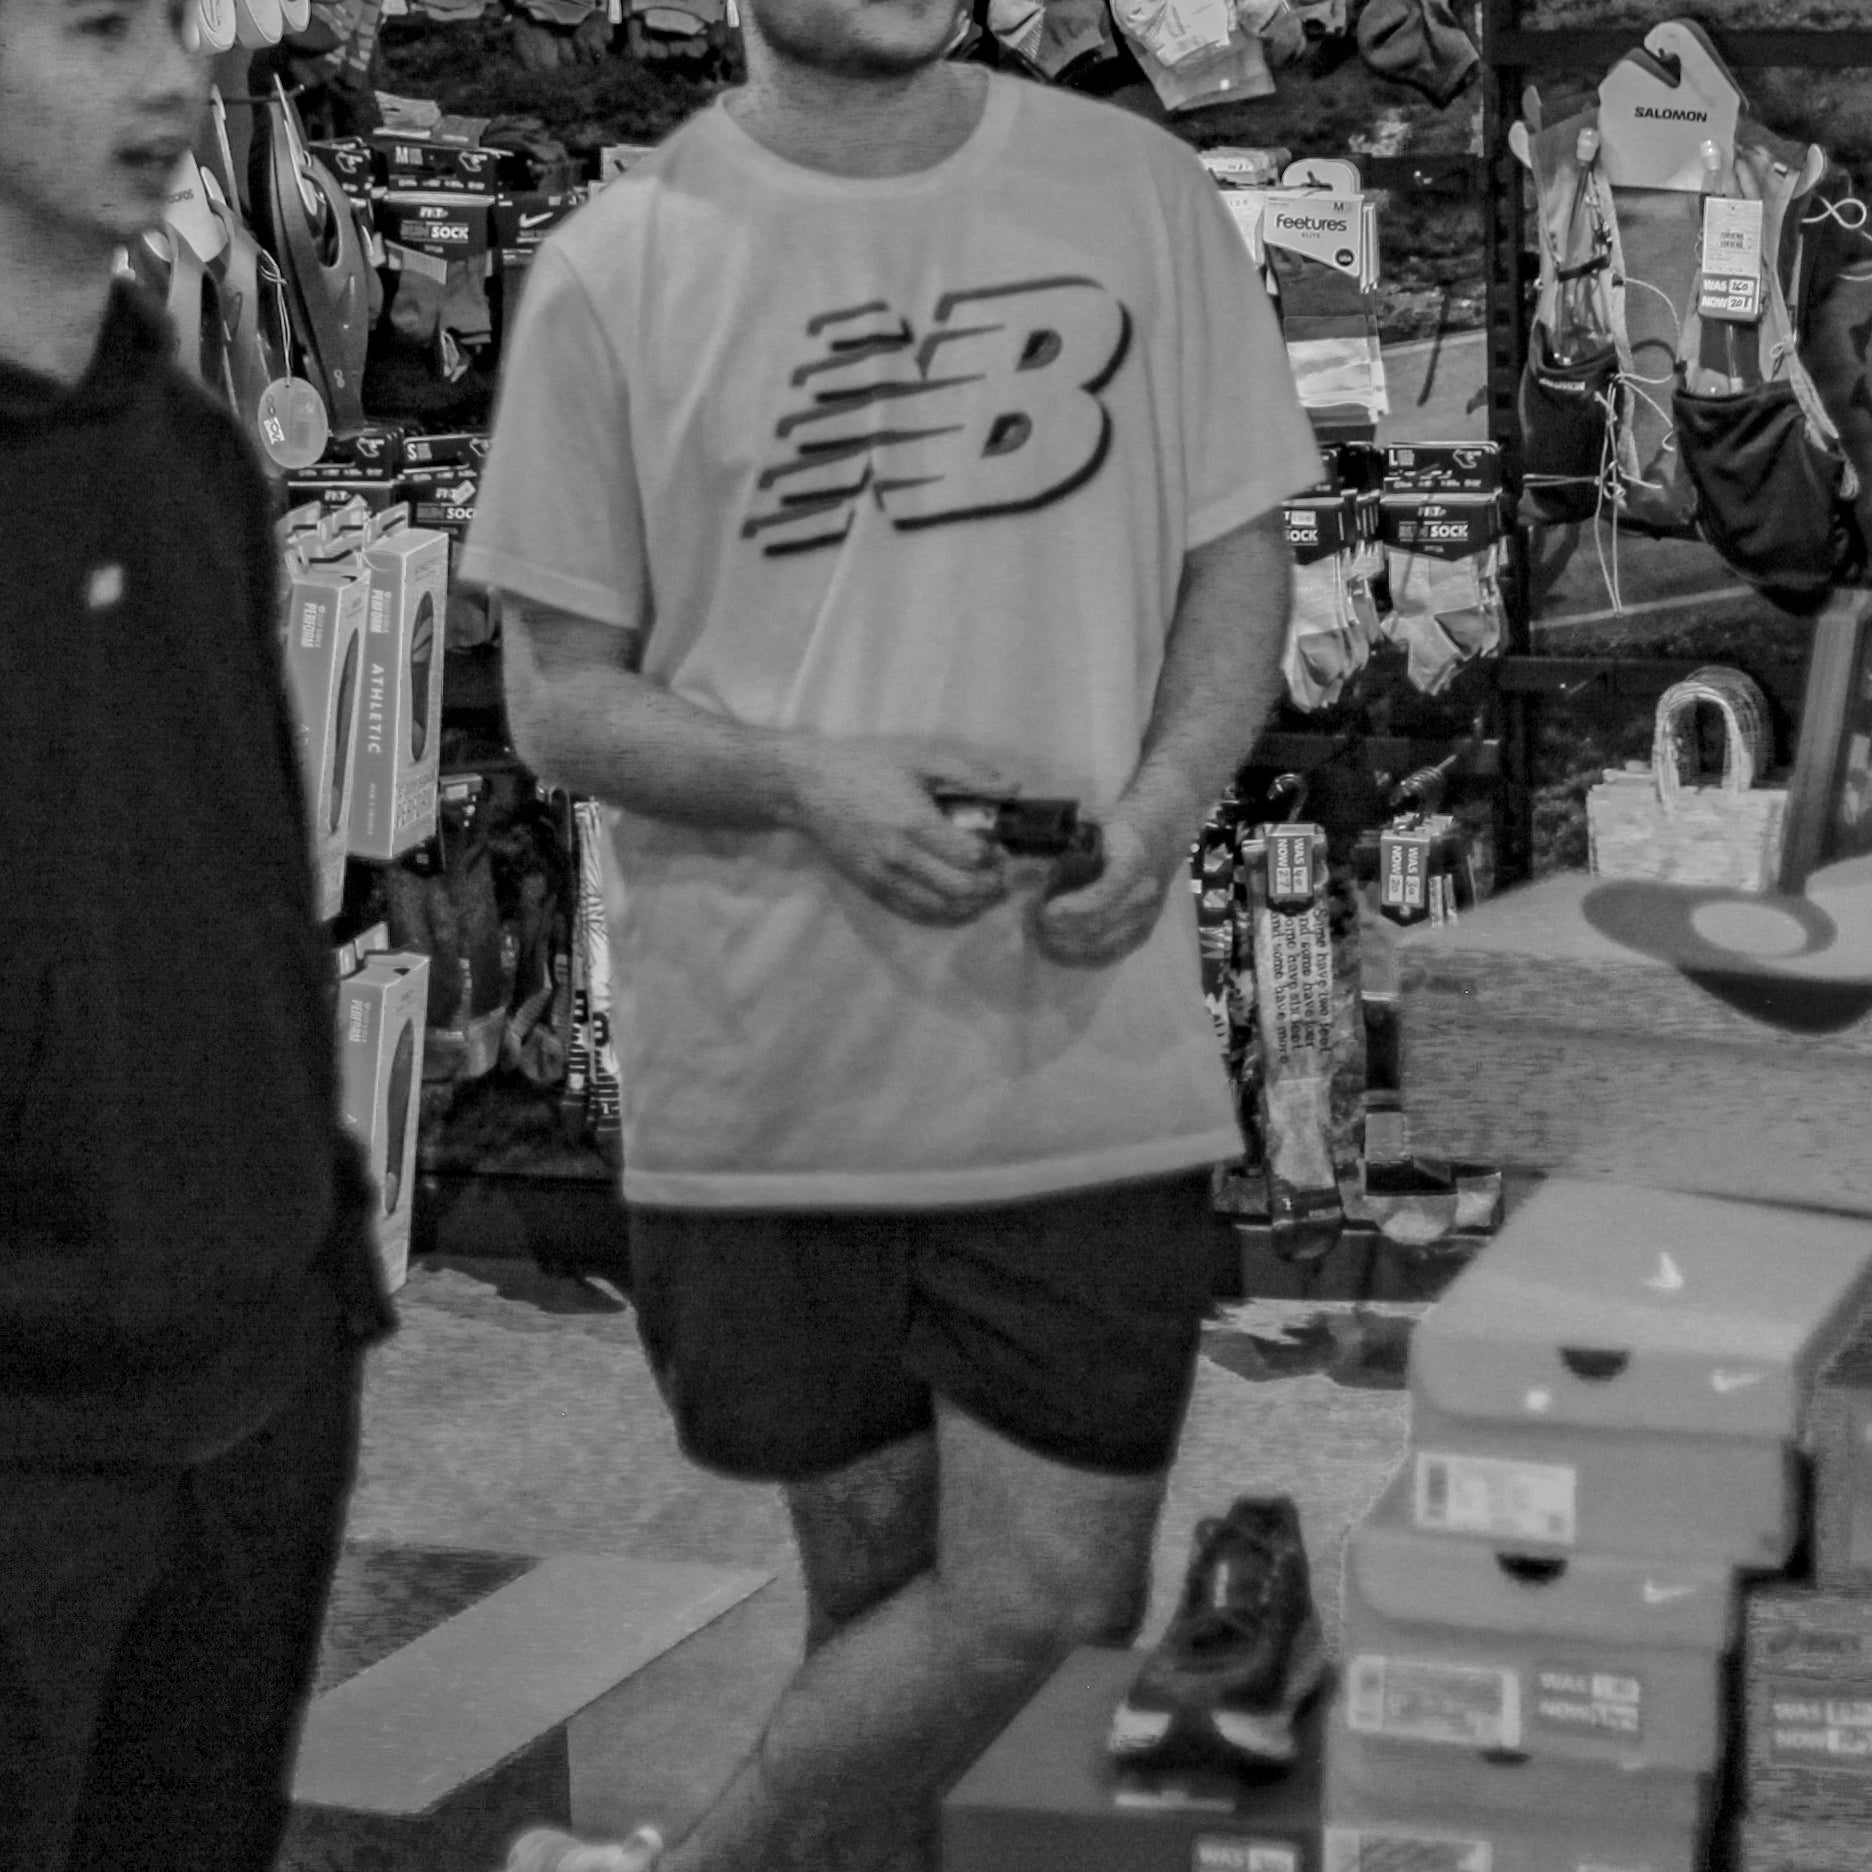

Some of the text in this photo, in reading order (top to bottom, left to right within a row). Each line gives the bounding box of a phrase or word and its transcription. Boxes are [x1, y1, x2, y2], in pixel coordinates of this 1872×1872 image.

[1634, 105, 1708, 123] SALOMON
[430, 225, 470, 240] SOCK
[1276, 213, 1348, 232] feetures
[1389, 449, 1399, 466] L
[1429, 524, 1470, 538] SOCK
[367, 662, 386, 755] ATHLETIC
[1277, 837, 1289, 868] NOW
[1293, 837, 1306, 866] WAS
[1391, 845, 1403, 875] NOW
[1406, 846, 1419, 875] WAS
[1285, 917, 1297, 950] ome
